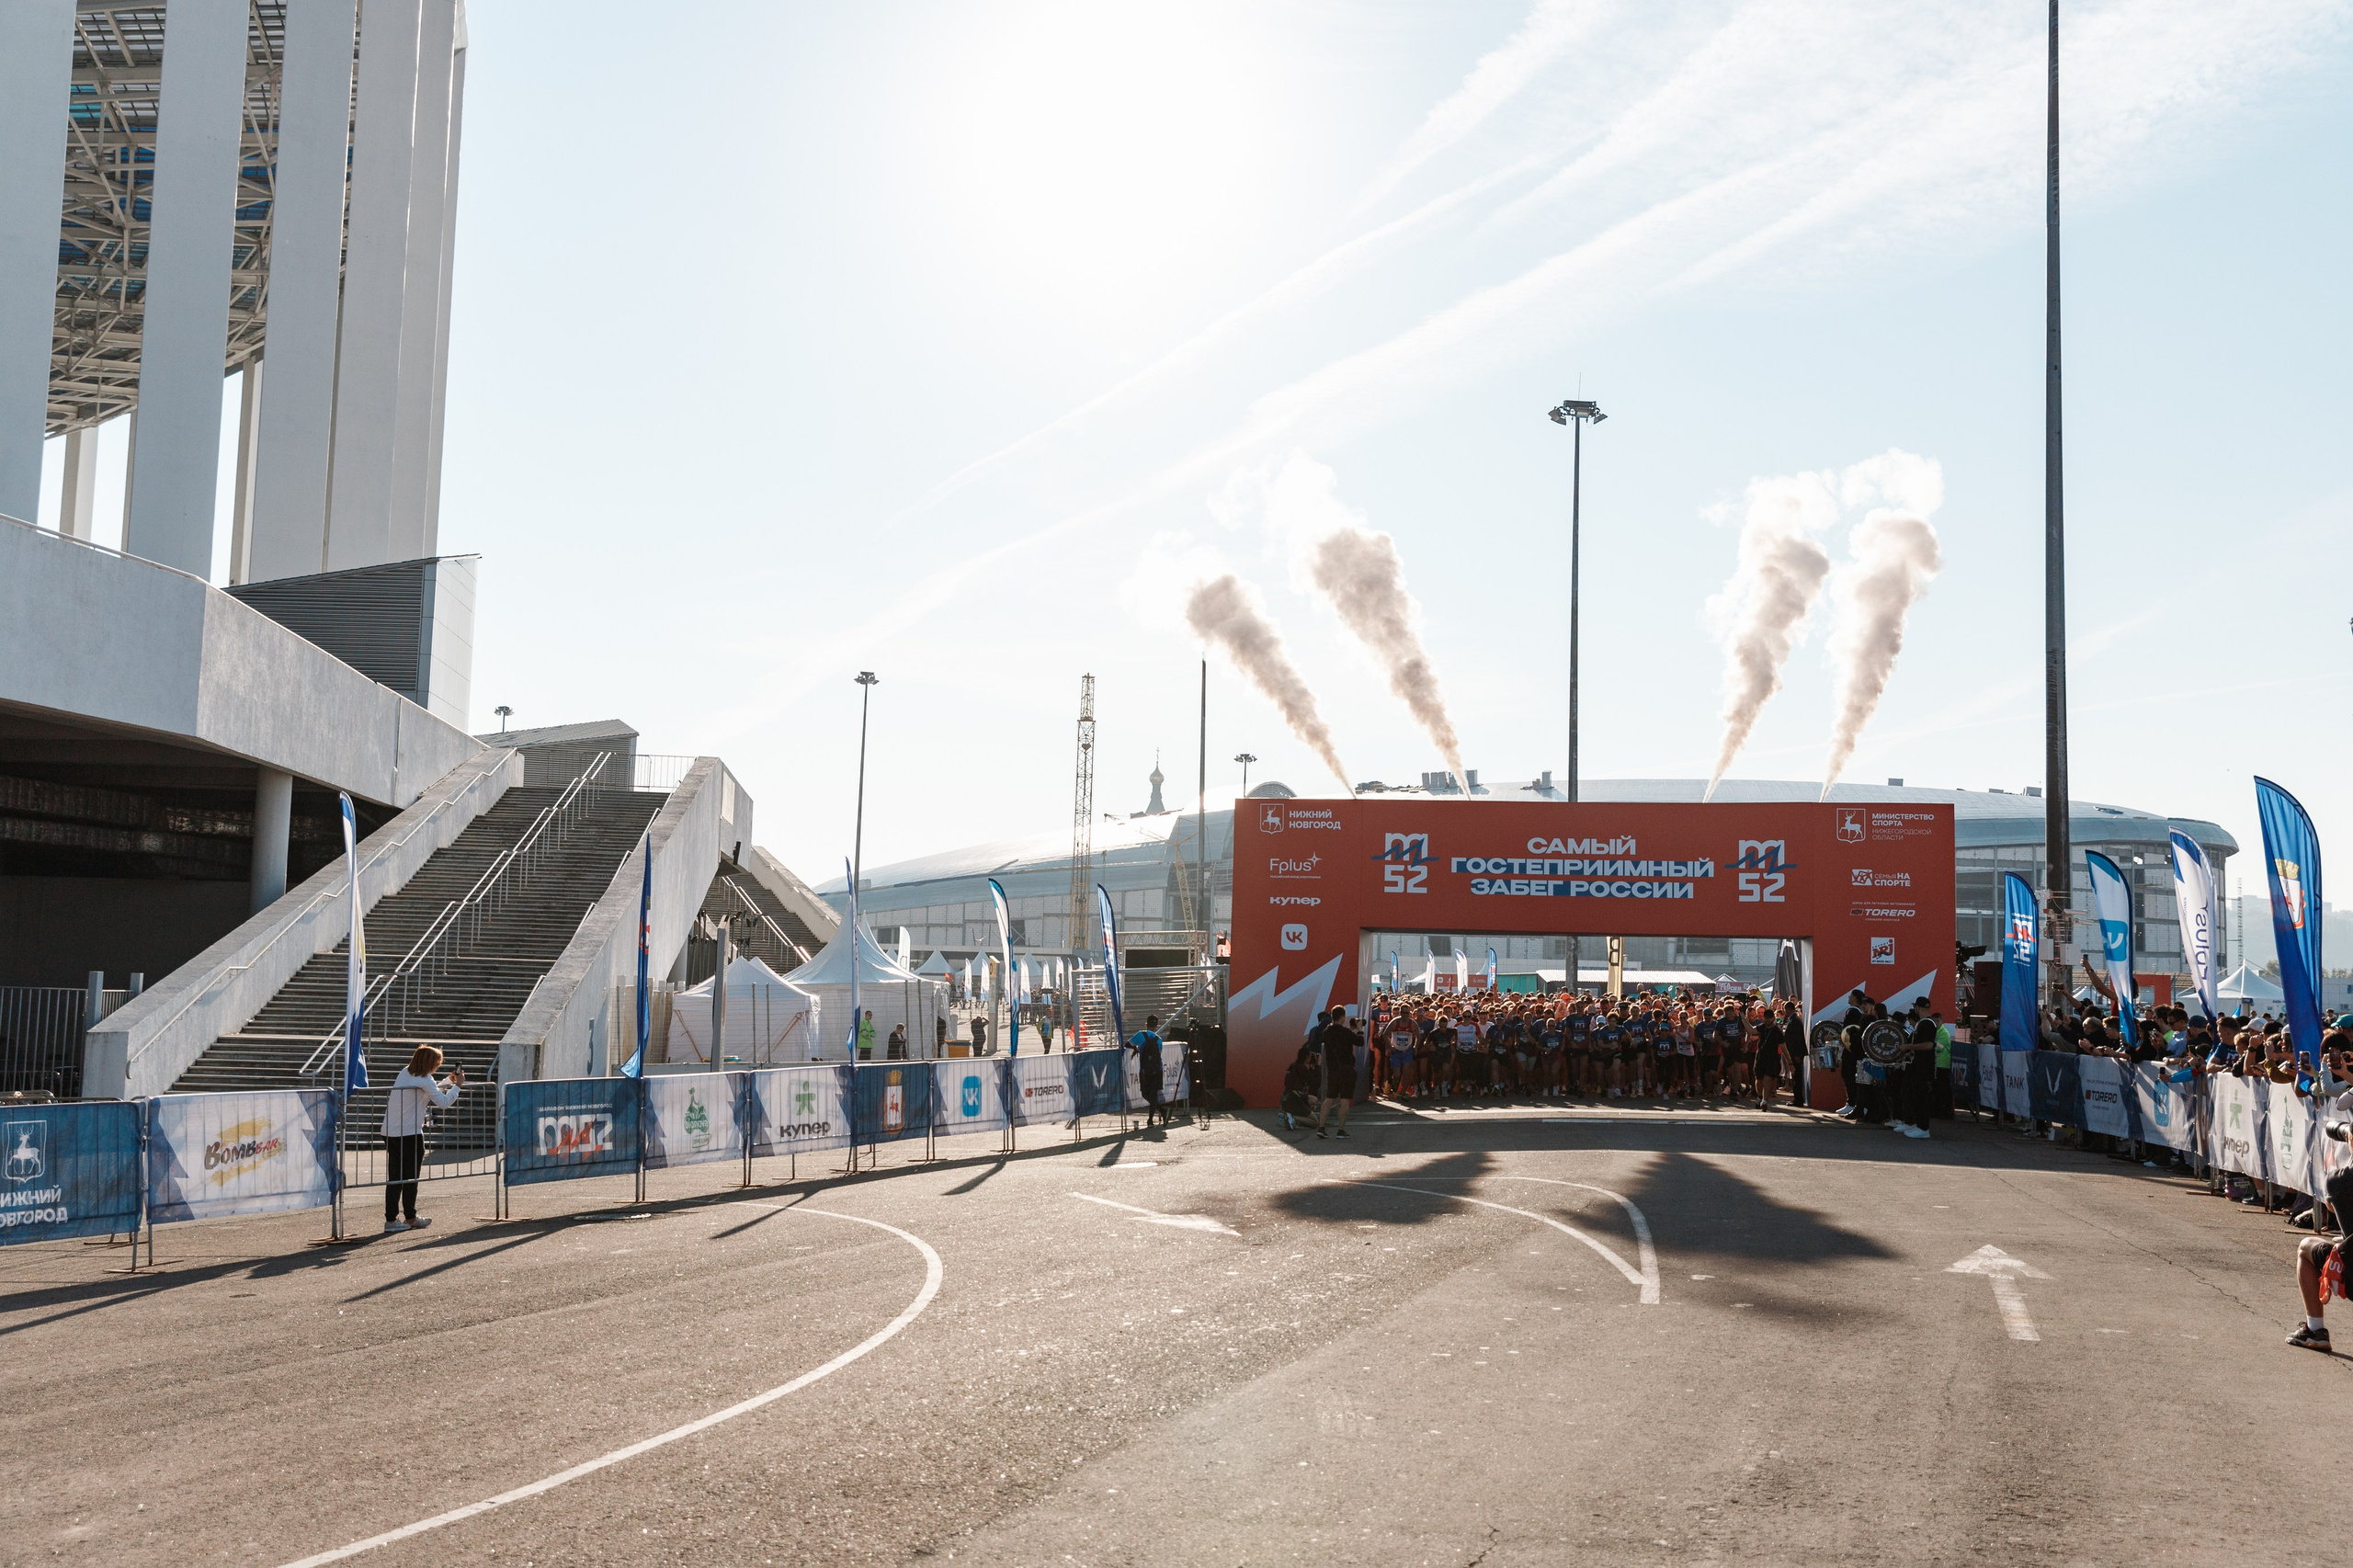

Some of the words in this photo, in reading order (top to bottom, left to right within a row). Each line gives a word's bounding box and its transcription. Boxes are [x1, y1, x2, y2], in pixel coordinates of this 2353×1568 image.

[1289, 809, 1333, 819] НИЖНИЙ
[1871, 812, 1935, 821] МИНИСТЕРСТВО
[1289, 821, 1342, 830] НОВГОРОД
[1527, 835, 1636, 856] САМЫЙ
[1269, 858, 1312, 874] Fplus
[1450, 857, 1715, 878] ГОСТЕПРИИМНЫЙ
[1384, 864, 1428, 894] 52
[1738, 872, 1785, 903] 52
[1471, 878, 1563, 896] ЗАБЕГ
[1570, 880, 1694, 900] РОССИИ
[1269, 896, 1321, 906] купер
[1864, 908, 1915, 917] TORERO
[1034, 1084, 1064, 1096] TORERO
[2006, 1074, 2025, 1091] TANK
[2092, 1090, 2118, 1105] TORERO
[780, 1120, 832, 1140] купер
[0, 1184, 63, 1208] ИЖНИЙ
[0, 1207, 68, 1228] ОВГОРОД
